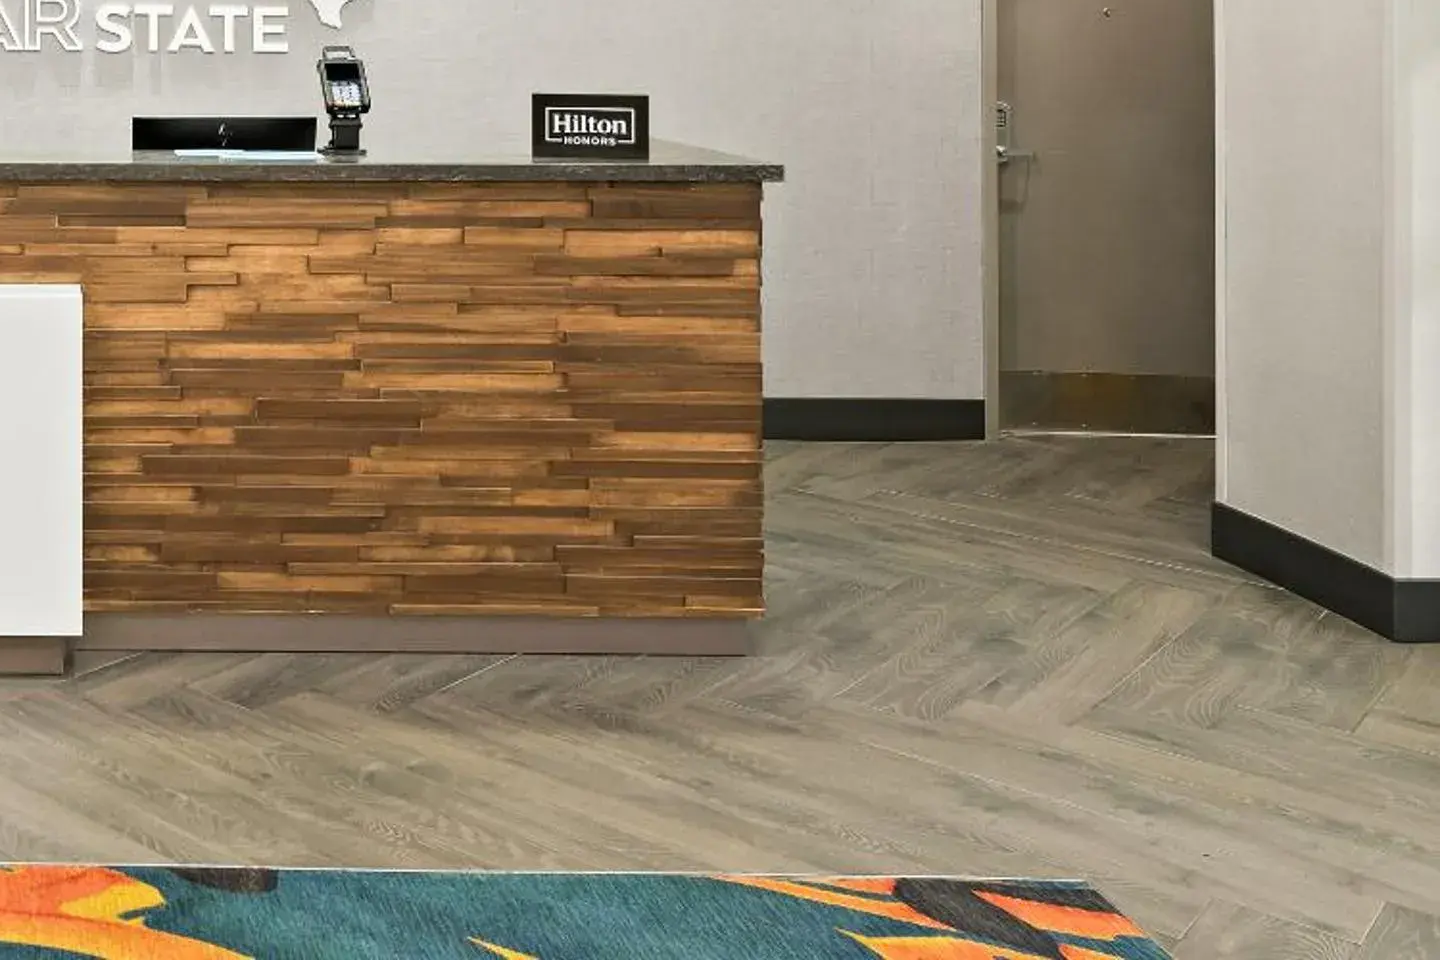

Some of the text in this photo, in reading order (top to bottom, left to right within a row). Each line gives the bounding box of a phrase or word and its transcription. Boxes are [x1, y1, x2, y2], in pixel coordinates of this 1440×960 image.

[95, 3, 290, 54] STATE
[553, 113, 627, 135] Hilton
[563, 136, 617, 146] HONORS
